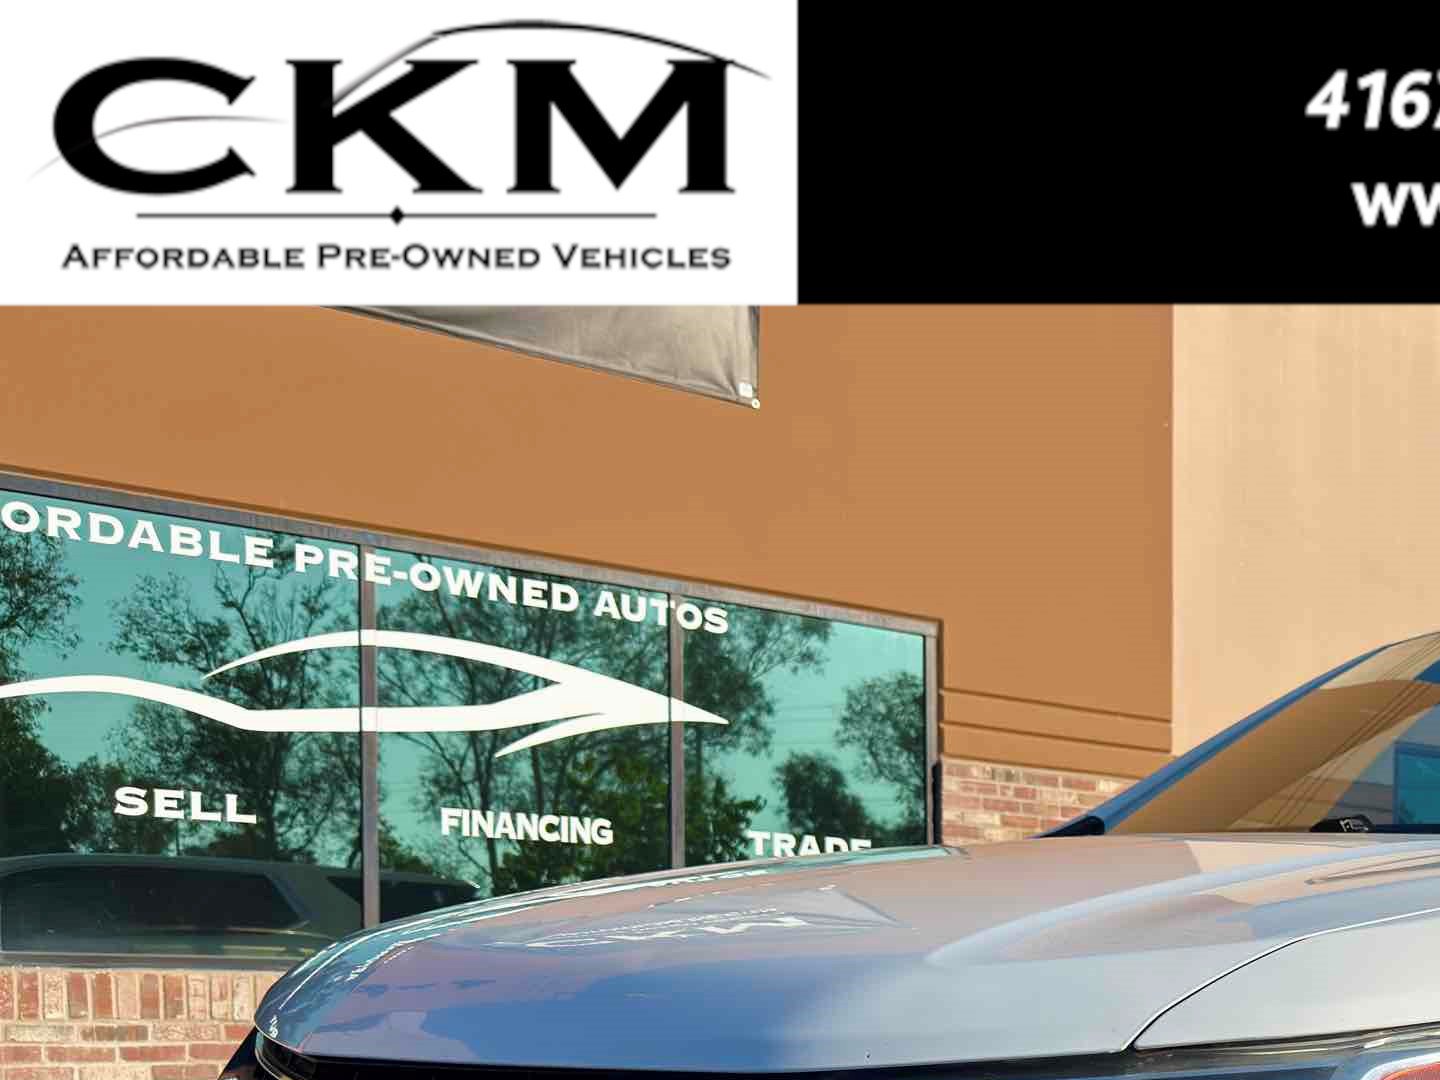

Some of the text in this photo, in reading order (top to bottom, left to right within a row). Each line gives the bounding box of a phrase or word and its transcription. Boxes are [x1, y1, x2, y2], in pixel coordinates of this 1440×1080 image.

[294, 543, 580, 613] PRE-OWNED
[592, 590, 729, 634] AUTOS
[114, 786, 257, 824] SELL
[440, 807, 615, 846] FINANCING
